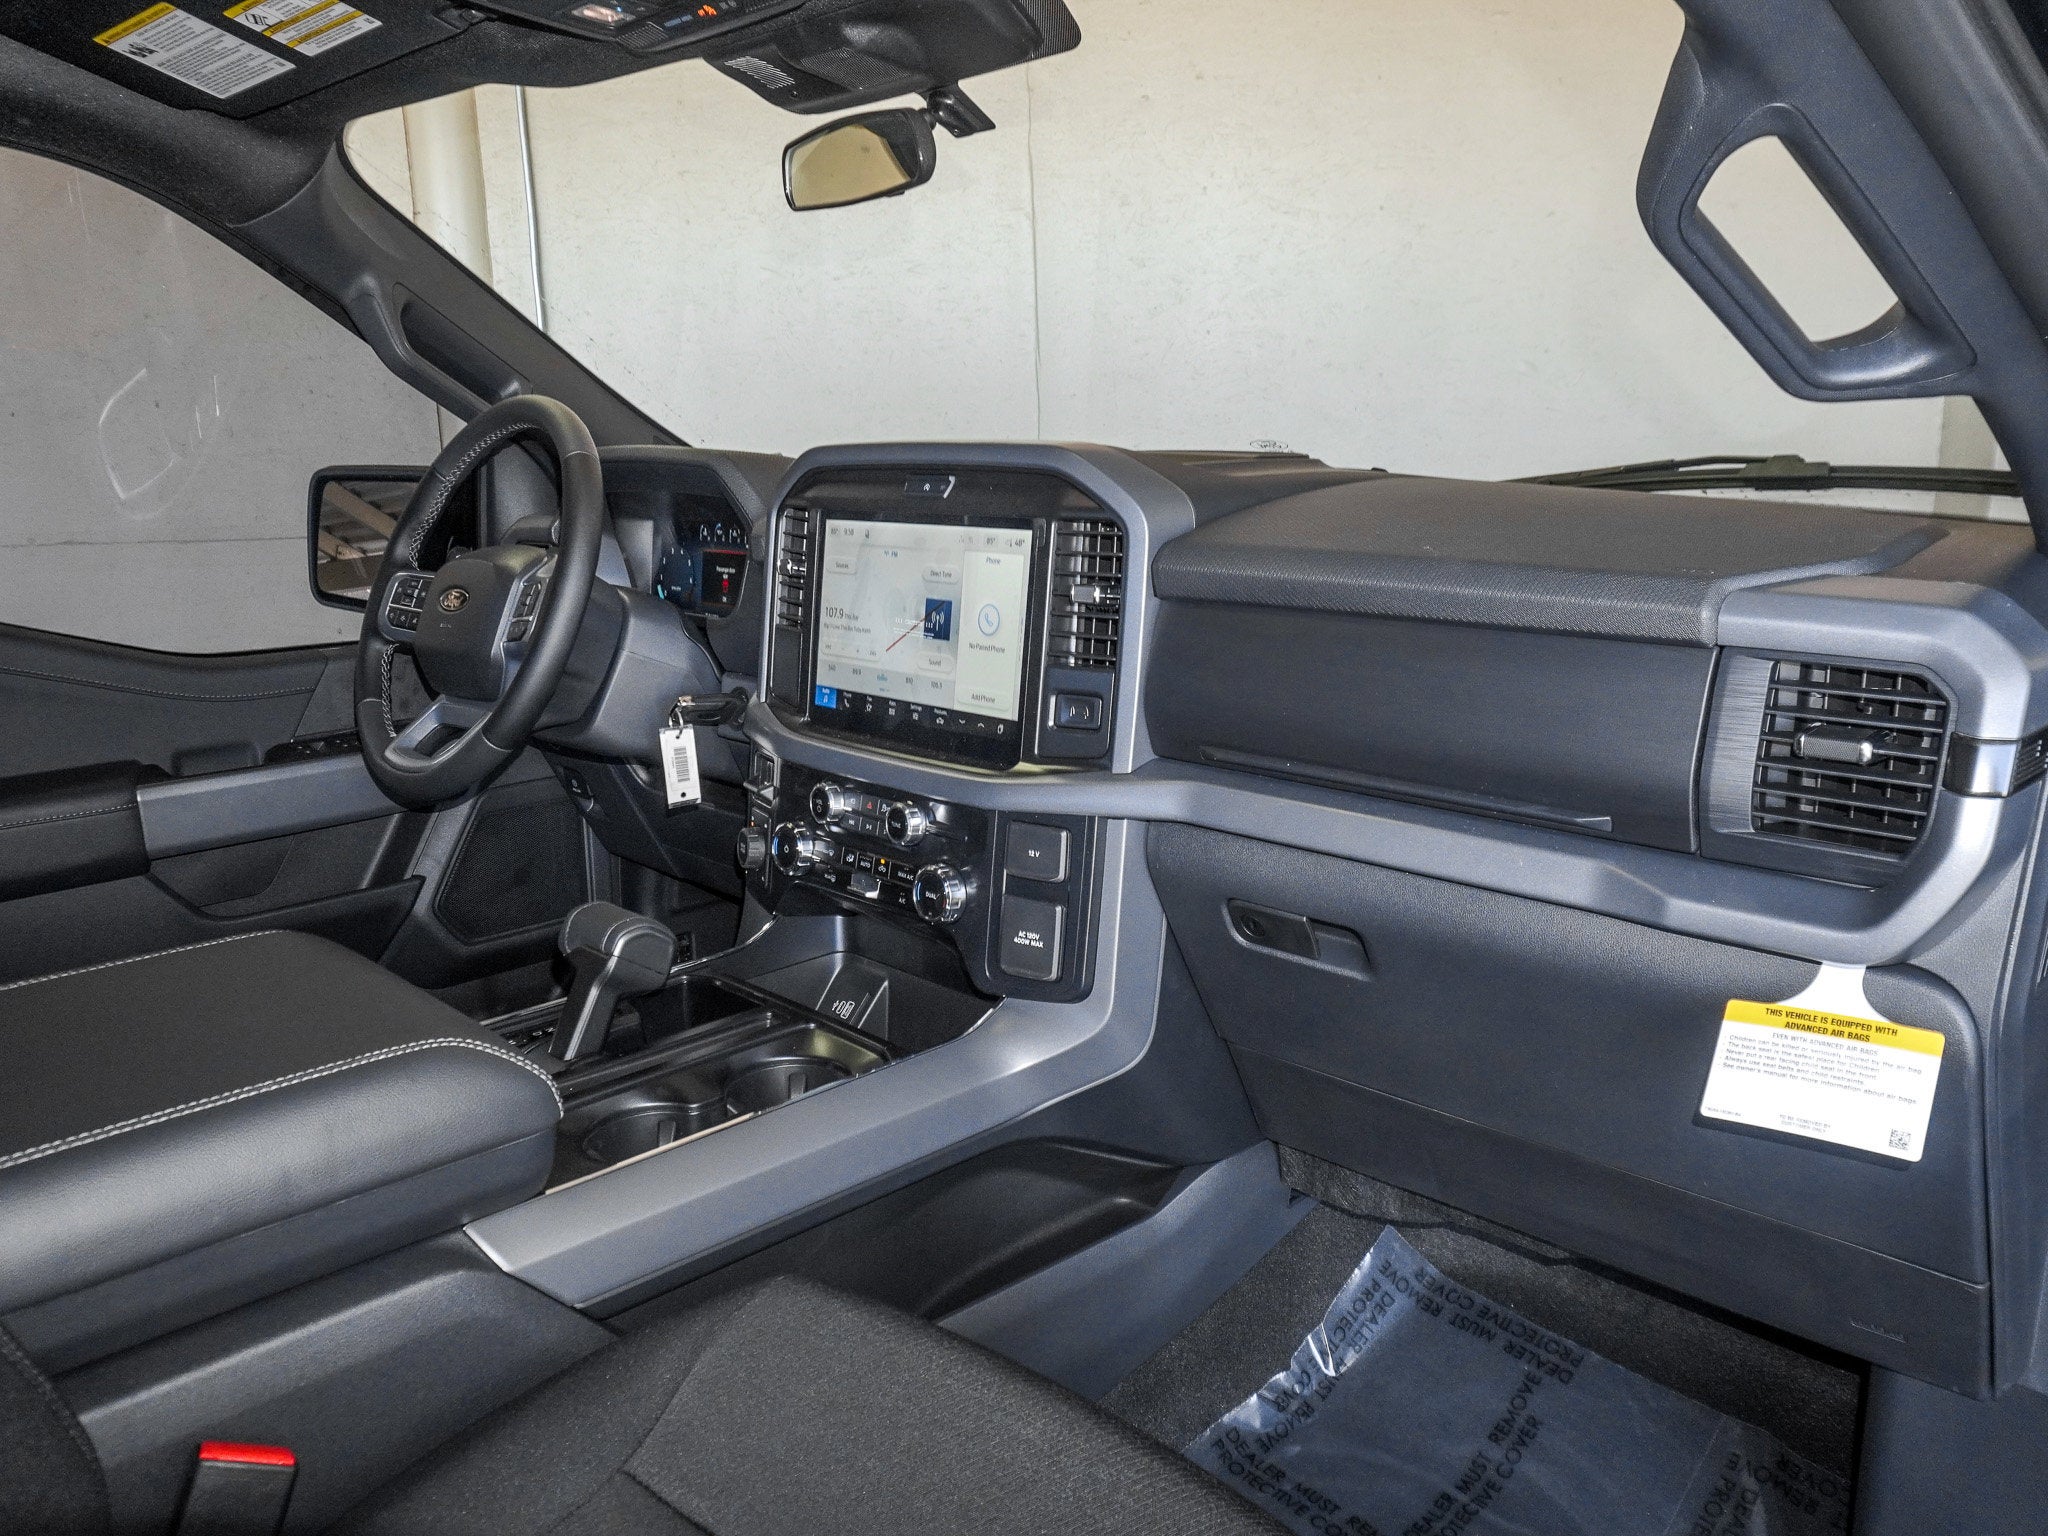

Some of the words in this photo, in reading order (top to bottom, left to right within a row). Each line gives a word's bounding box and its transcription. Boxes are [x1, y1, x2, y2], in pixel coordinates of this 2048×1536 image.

[825, 606, 844, 620] 107.9
[1013, 936, 1031, 946] 400W
[1030, 938, 1044, 948] MAX
[1018, 930, 1026, 938] AC
[1027, 931, 1040, 941] 120V
[1765, 1007, 1783, 1017] THIS
[1785, 1011, 1818, 1023] VEHICLE
[1830, 1018, 1872, 1032] EQUIPPED
[1874, 1026, 1898, 1036] WITH
[1784, 1021, 1828, 1035] ADVANCED
[1830, 1029, 1845, 1038] AIR
[1847, 1032, 1870, 1042] BAGS
[1380, 1261, 1444, 1318] REMOVE
[1412, 1265, 1475, 1310] COVER
[1353, 1291, 1396, 1355] DEALER
[1449, 1313, 1496, 1342] MUST
[1476, 1304, 1585, 1368] PROTECTIVE
[1504, 1340, 1574, 1384] DEALER
[1455, 1451, 1491, 1494] MUST
[1488, 1371, 1541, 1446] REMOVE
[1496, 1414, 1542, 1479] COVER
[1211, 1438, 1311, 1514] PROTECTIVE
[1225, 1427, 1286, 1483] DEALER
[1294, 1482, 1341, 1515] MUST
